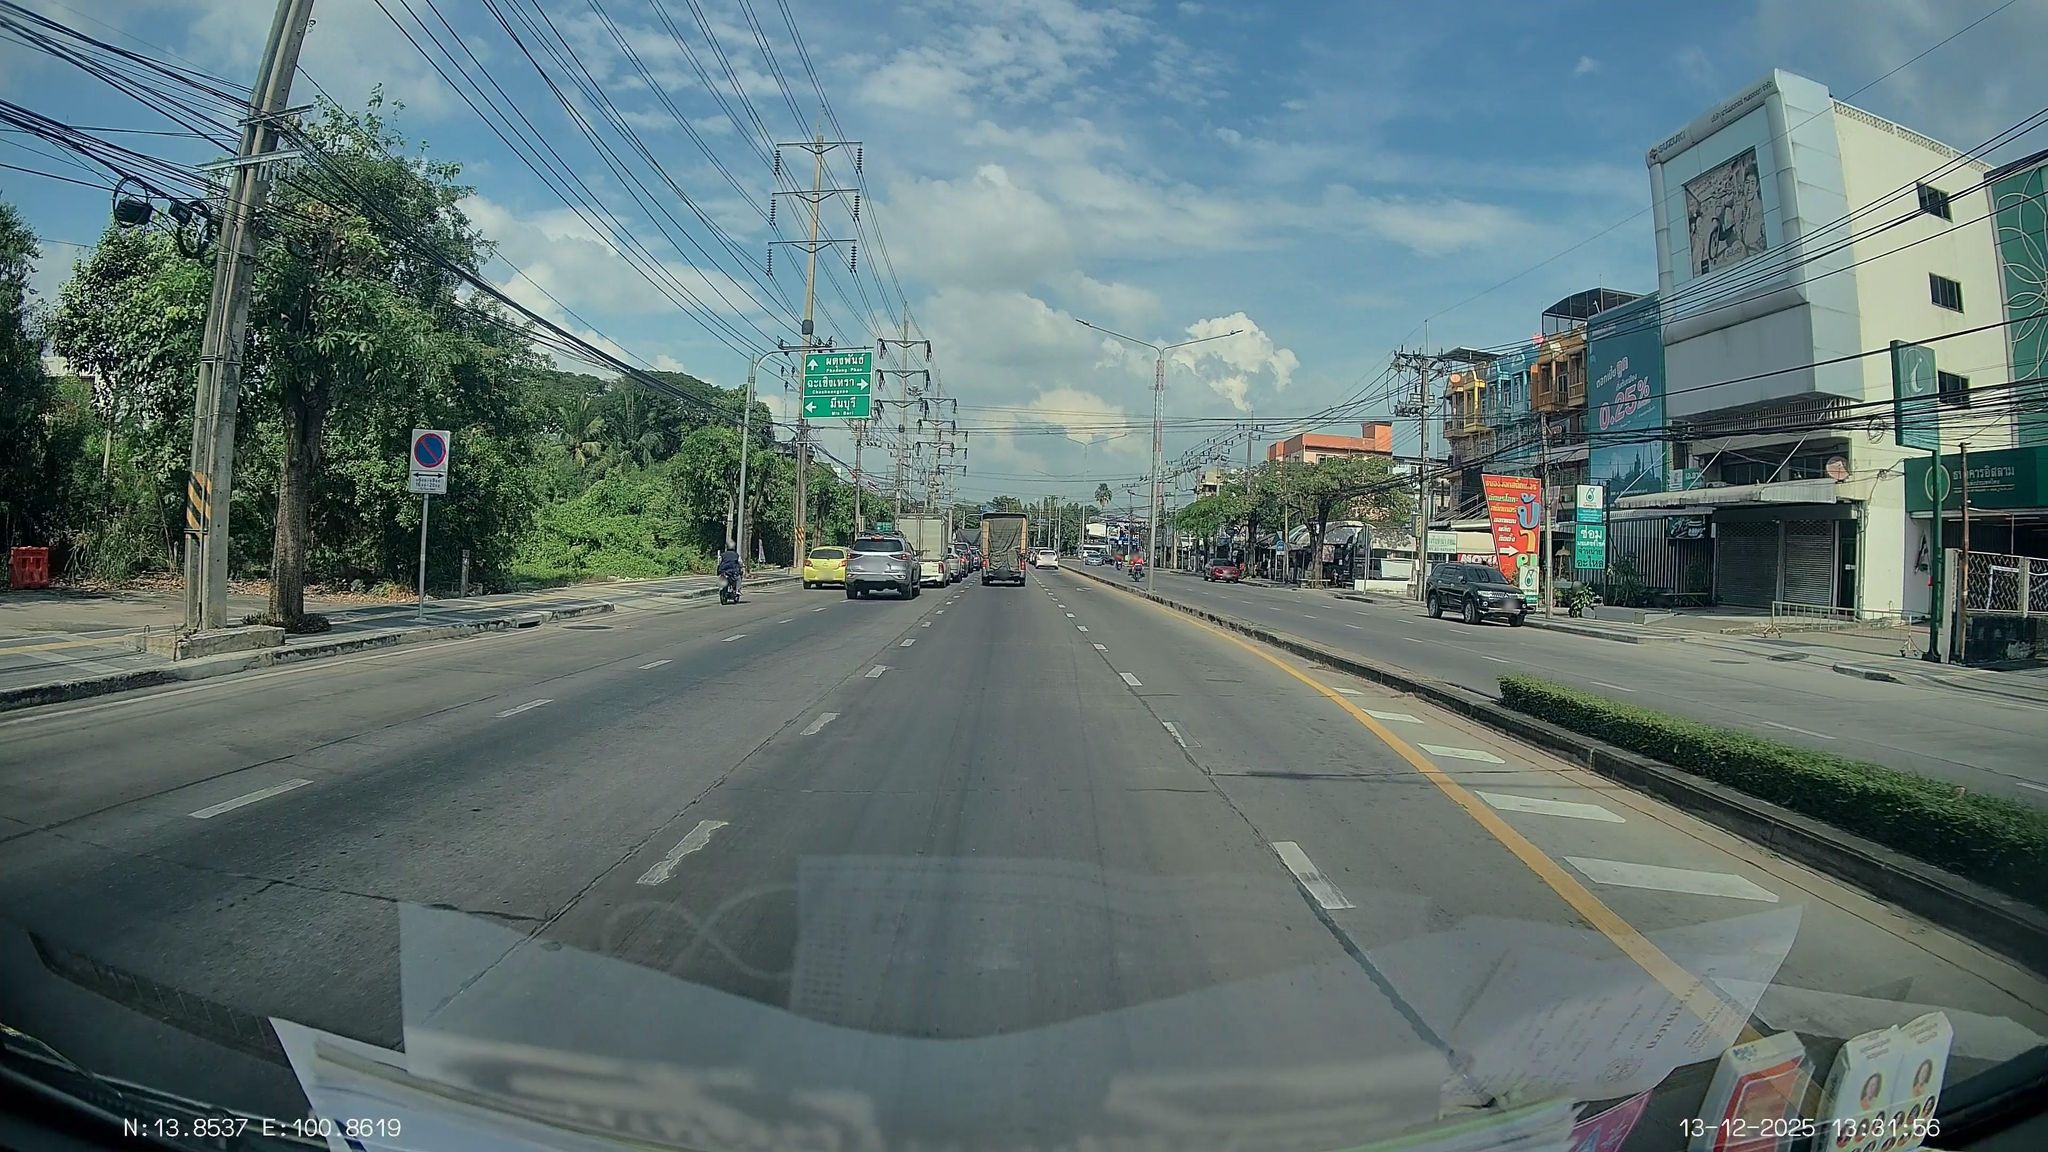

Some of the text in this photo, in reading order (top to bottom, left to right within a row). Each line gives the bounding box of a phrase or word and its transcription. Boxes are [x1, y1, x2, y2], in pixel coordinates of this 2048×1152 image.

[1658, 130, 1686, 153] SUZUKI
[807, 376, 855, 388] ฉะเชิงเทรา
[830, 397, 856, 411] มีนบุรี
[1600, 376, 1651, 430] 0.25%
[1581, 525, 1602, 539] ซ่อม
[1577, 556, 1604, 568] อะไหล่
